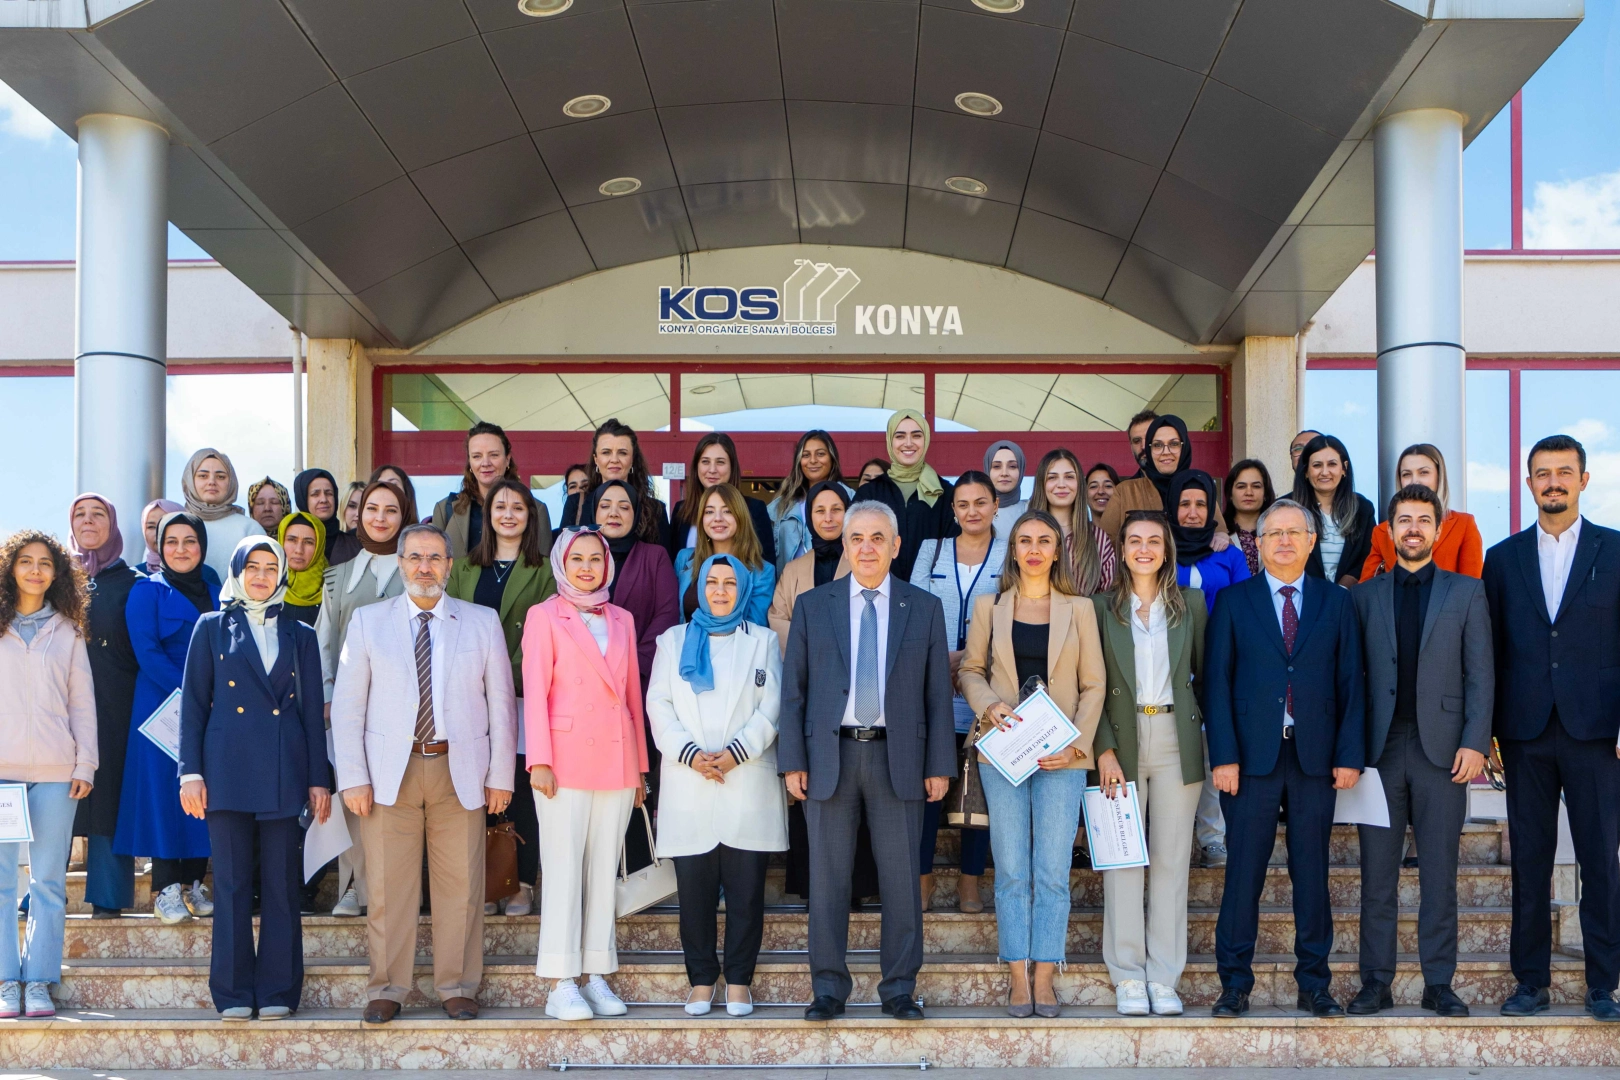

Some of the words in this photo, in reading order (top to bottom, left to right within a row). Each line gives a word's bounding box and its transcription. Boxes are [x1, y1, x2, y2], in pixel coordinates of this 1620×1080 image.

[659, 286, 779, 321] KOS
[659, 324, 696, 333] KONYA
[698, 323, 749, 334] ORGANİZE
[751, 324, 789, 334] SANAYİ
[791, 324, 836, 334] BÖLGESİ
[855, 304, 964, 335] KONYA
[664, 465, 683, 475] 12/E
[1120, 830, 1129, 857] BELGESİ
